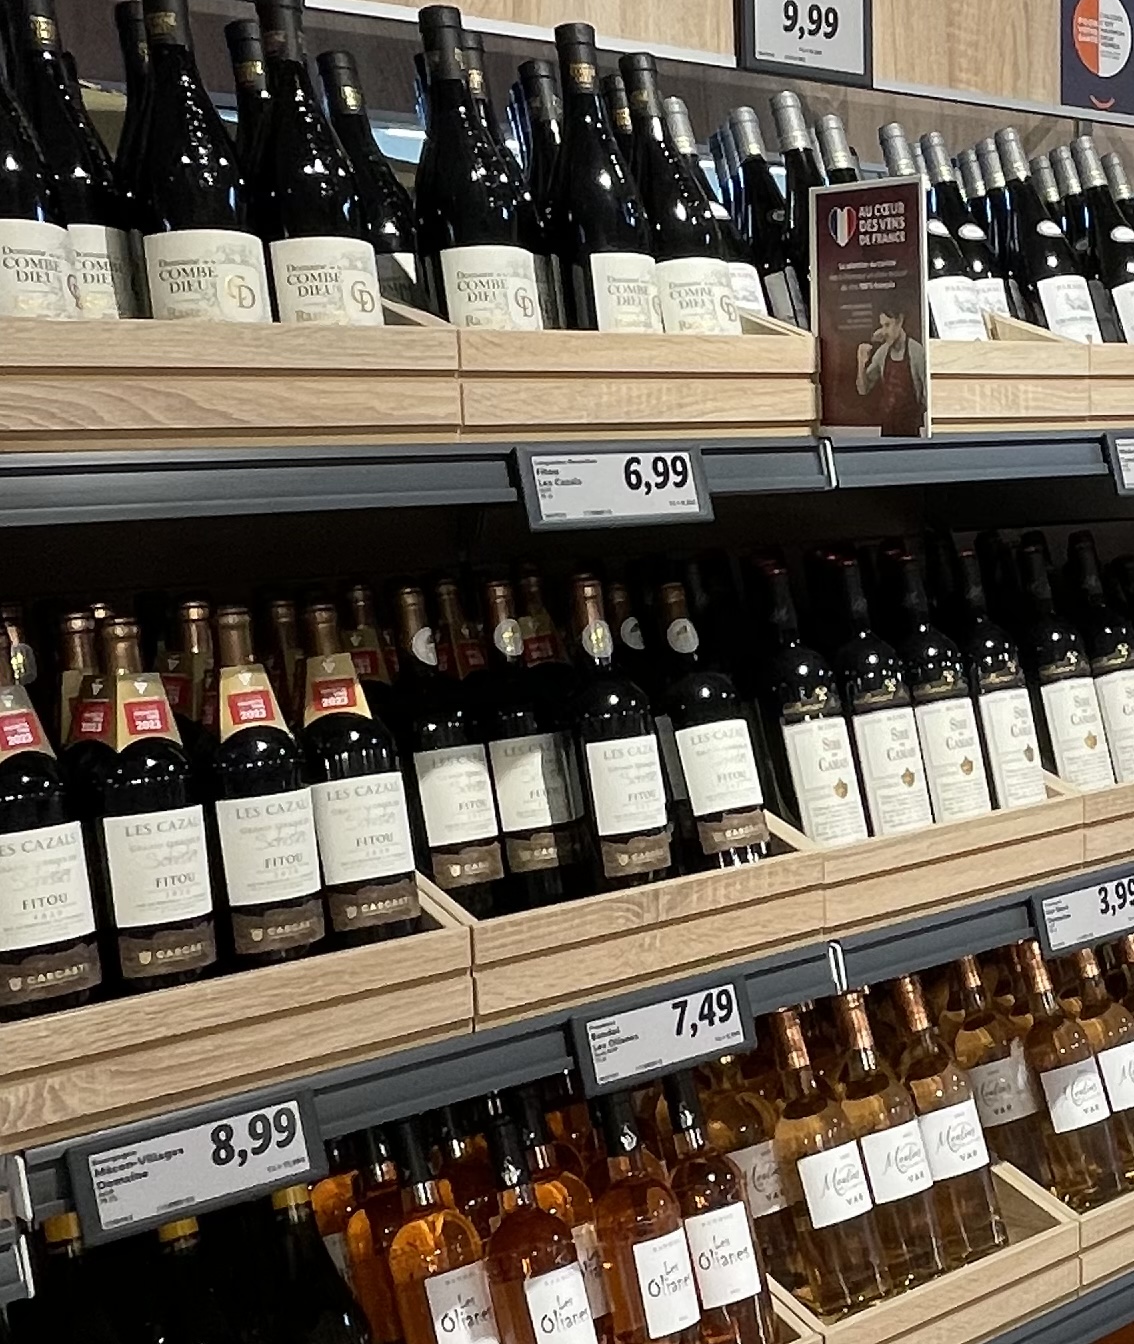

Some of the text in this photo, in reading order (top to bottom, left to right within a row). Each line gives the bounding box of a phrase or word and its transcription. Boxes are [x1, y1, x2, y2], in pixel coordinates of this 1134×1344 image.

[782, 0, 839, 40] 9,99
[858, 201, 905, 218] AU CŒUR
[859, 215, 906, 232] DES VINS
[859, 231, 906, 246] DE FRANCE
[158, 266, 218, 282] COMBE
[286, 271, 342, 286] COMBE
[169, 279, 206, 294] DIEU
[298, 284, 335, 297] DIEU
[456, 277, 509, 291] COMBE
[607, 284, 648, 296] COMBE
[624, 456, 689, 496] 6,99
[326, 789, 351, 802] LES
[236, 807, 261, 820] LES
[124, 818, 200, 838] LES CAZAL
[0, 832, 78, 857] ES CAZALS
[355, 832, 394, 847] FITOU
[264, 853, 304, 869] FITOU
[155, 872, 196, 888] FITOU
[22, 893, 69, 911] FITOU
[672, 989, 733, 1038] 7,49
[210, 1107, 297, 1167] 8,99
[699, 1246, 750, 1270] Olianes
